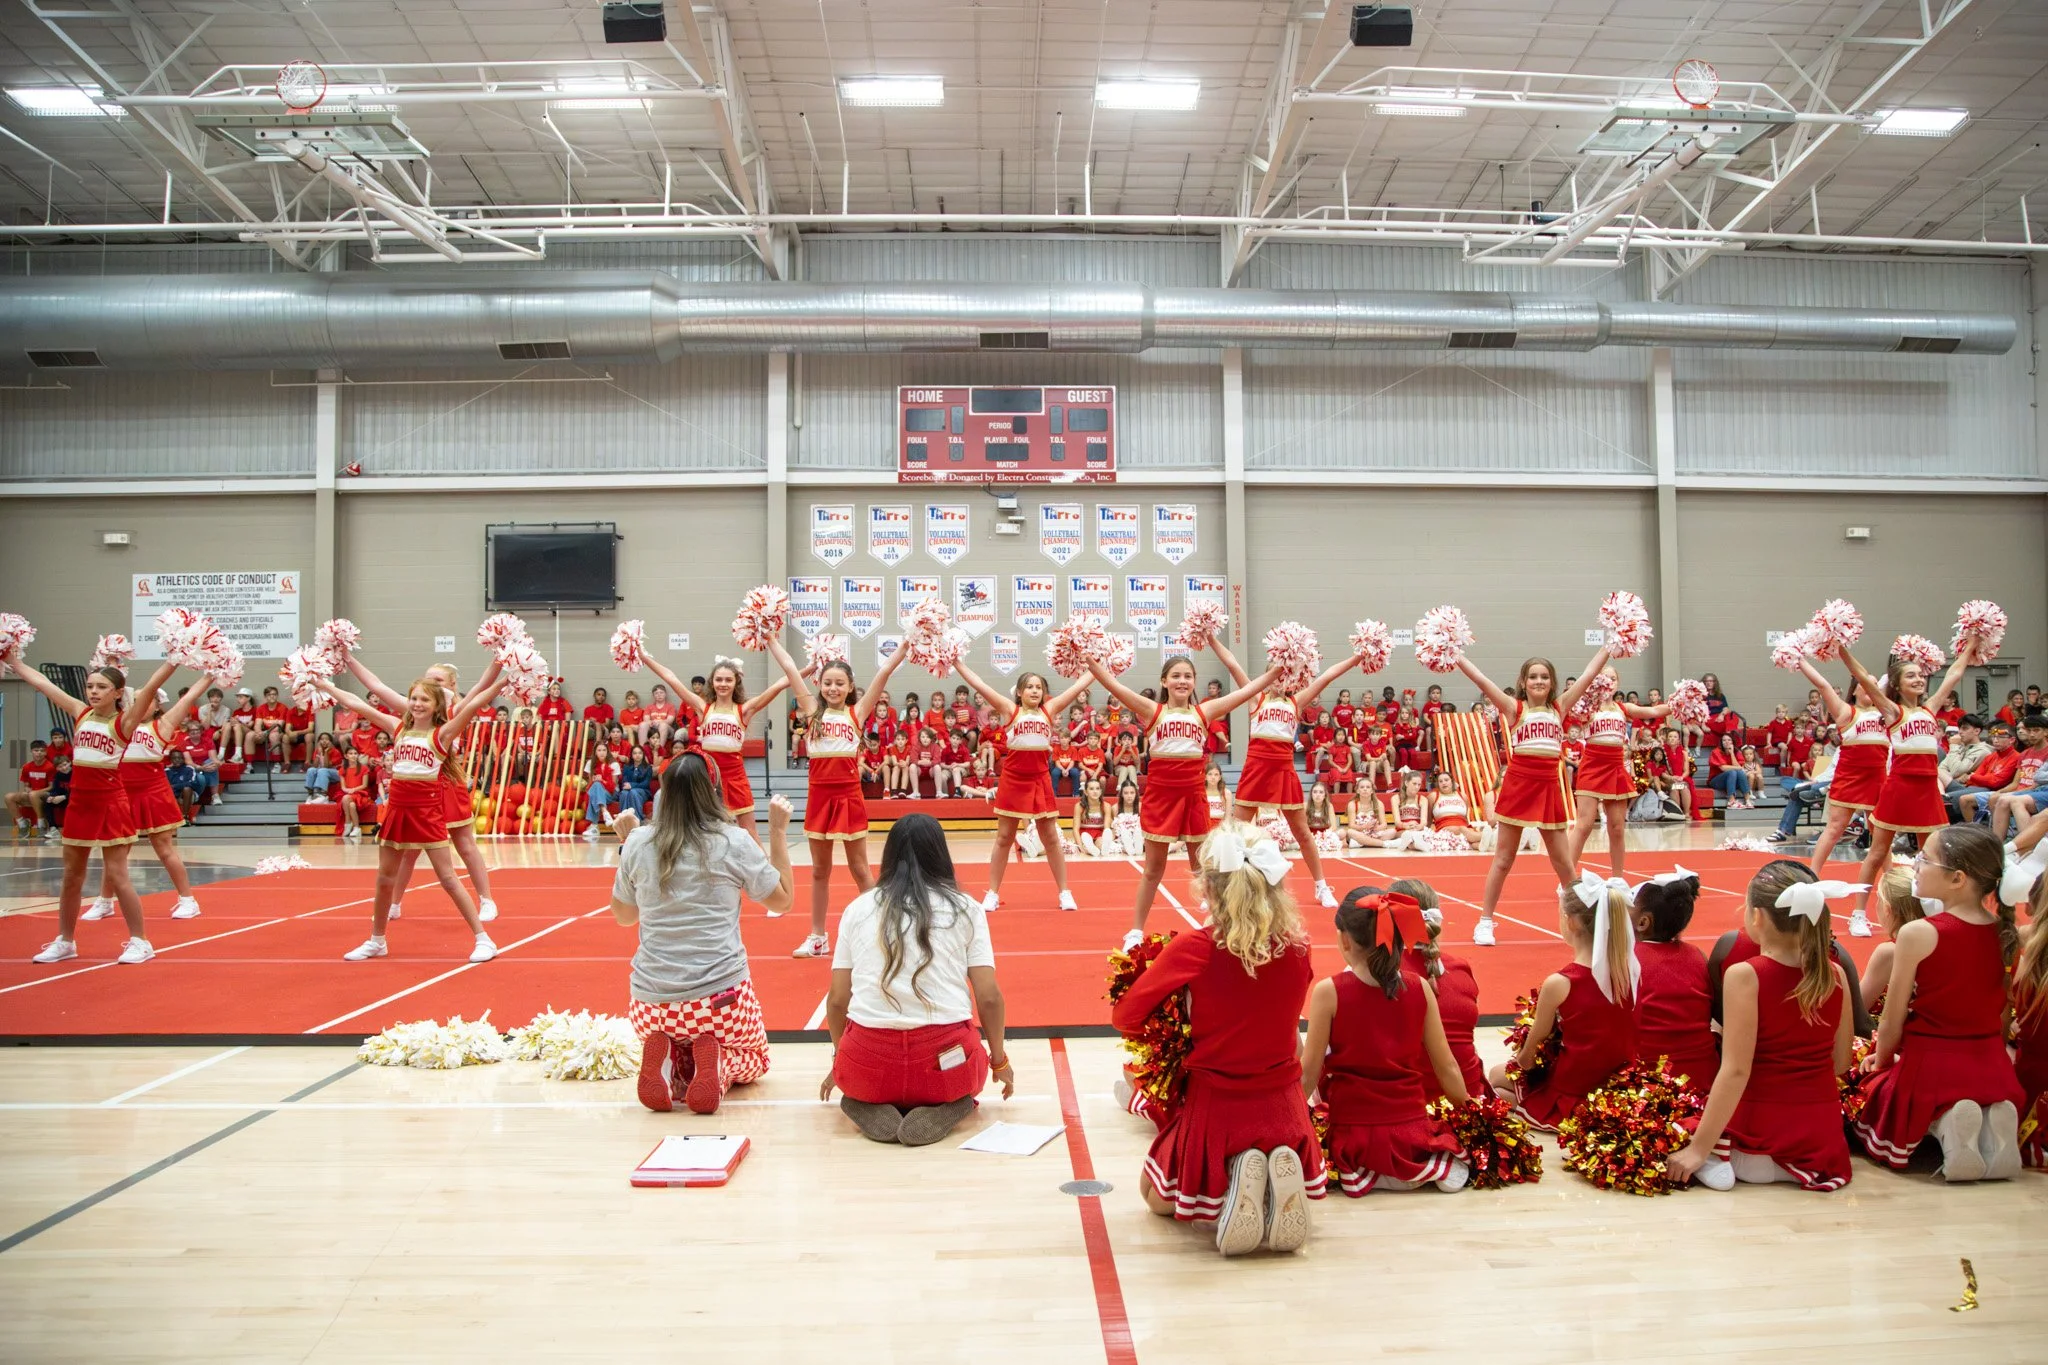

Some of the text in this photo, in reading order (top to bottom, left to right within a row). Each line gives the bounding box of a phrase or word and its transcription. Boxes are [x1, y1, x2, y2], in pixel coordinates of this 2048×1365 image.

[907, 390, 944, 402] HOME
[1067, 390, 1108, 402] GUEST
[988, 422, 1012, 430] PERIOD
[907, 436, 928, 444] FOULS
[984, 436, 1030, 444] PLAYER FOUL
[1086, 436, 1107, 444] FOULS
[902, 473, 947, 482] Scoreboard
[949, 473, 983, 482] Donated
[985, 474, 996, 482] by
[996, 473, 1024, 482] Electra
[1026, 473, 1077, 482] Construc
[1097, 473, 1112, 481] Inc.
[929, 530, 965, 538] VOLLEYBALL
[1044, 530, 1080, 538] VOLLEYBALL
[815, 538, 852, 546] CHAMPIONS
[872, 538, 909, 546] CHAMPION
[928, 538, 966, 546] CHAMPION
[1043, 538, 1080, 546] CHAMPION
[1100, 538, 1136, 546] RUNNERUP
[824, 549, 843, 557] 2018
[156, 574, 276, 585] ATHLETICS CODE OF CONDUCT
[1016, 600, 1052, 608] TENNIS
[792, 610, 828, 618] CHAMPION
[844, 610, 880, 618] CHAMPIONS
[1016, 608, 1052, 616] CHAMPION
[1129, 608, 1166, 616] CHAMPION
[1232, 584, 1242, 644] WARRIORS
[957, 614, 994, 622] CHAMPION
[1014, 721, 1050, 736] WARRIORS
[1156, 721, 1202, 742] WARRIORS
